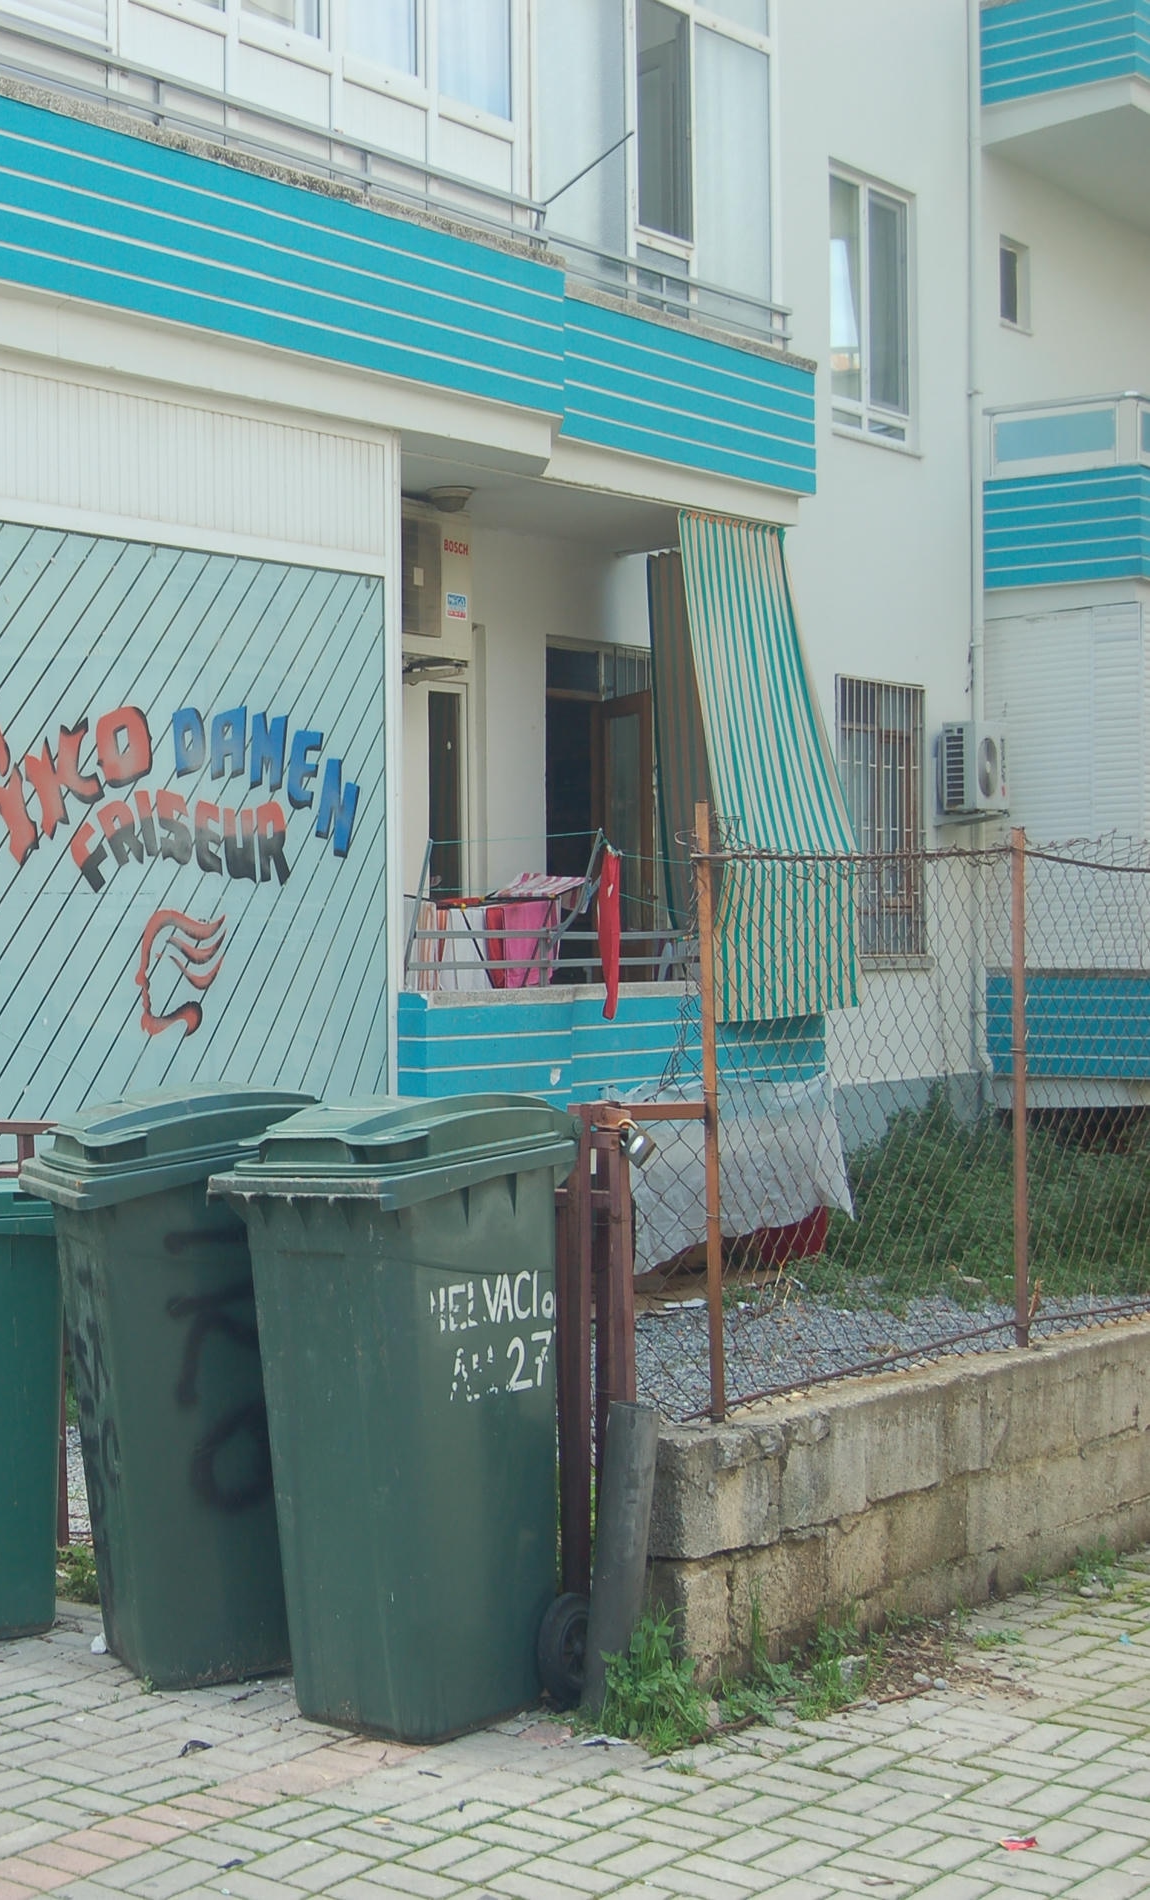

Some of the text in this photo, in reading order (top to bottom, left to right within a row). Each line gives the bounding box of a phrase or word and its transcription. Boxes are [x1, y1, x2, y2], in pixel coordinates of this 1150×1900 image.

[443, 538, 469, 556] BOSCH
[172, 704, 361, 859] DAMEN
[69, 788, 291, 894] FRISEUR
